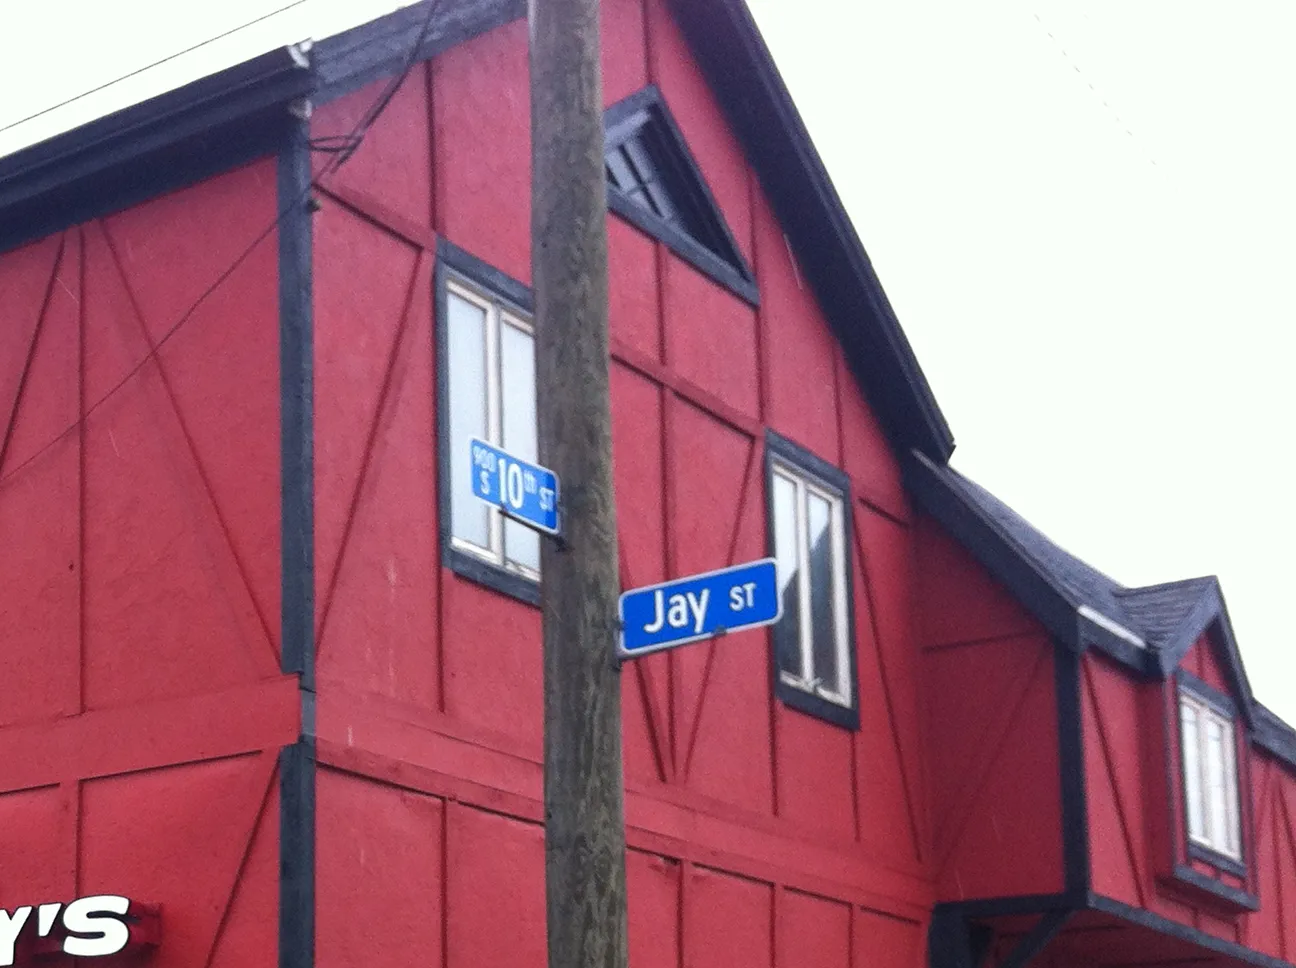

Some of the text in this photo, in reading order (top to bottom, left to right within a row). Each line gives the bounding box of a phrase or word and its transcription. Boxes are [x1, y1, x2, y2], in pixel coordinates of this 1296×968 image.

[480, 471, 491, 496] S
[540, 487, 555, 512] ST
[643, 582, 756, 635] Jay ST
